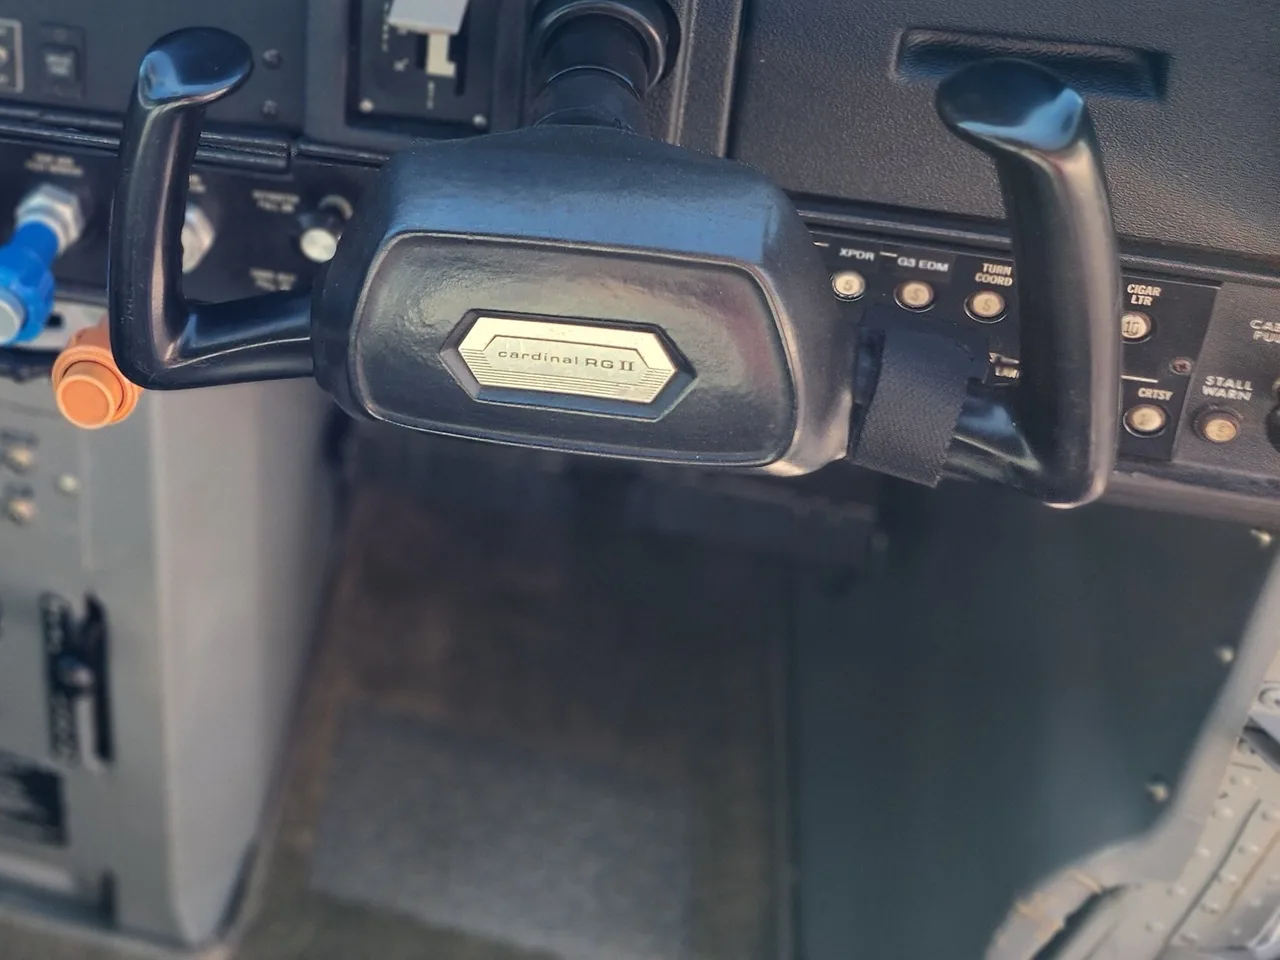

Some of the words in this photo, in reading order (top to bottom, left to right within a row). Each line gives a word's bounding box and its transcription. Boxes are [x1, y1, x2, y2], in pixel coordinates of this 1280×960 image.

[840, 248, 876, 262] XPDR
[918, 259, 950, 272] EDM
[982, 263, 1012, 276] TURN
[975, 273, 1014, 287] COORD
[1126, 284, 1162, 296] CIGAR
[1131, 295, 1153, 306] LTR
[498, 350, 578, 365] cardinal
[585, 358, 614, 370] RG
[620, 360, 635, 372] II
[1205, 376, 1253, 391] STALL
[1138, 388, 1174, 401] CRTSY
[1202, 386, 1252, 402] WARN
